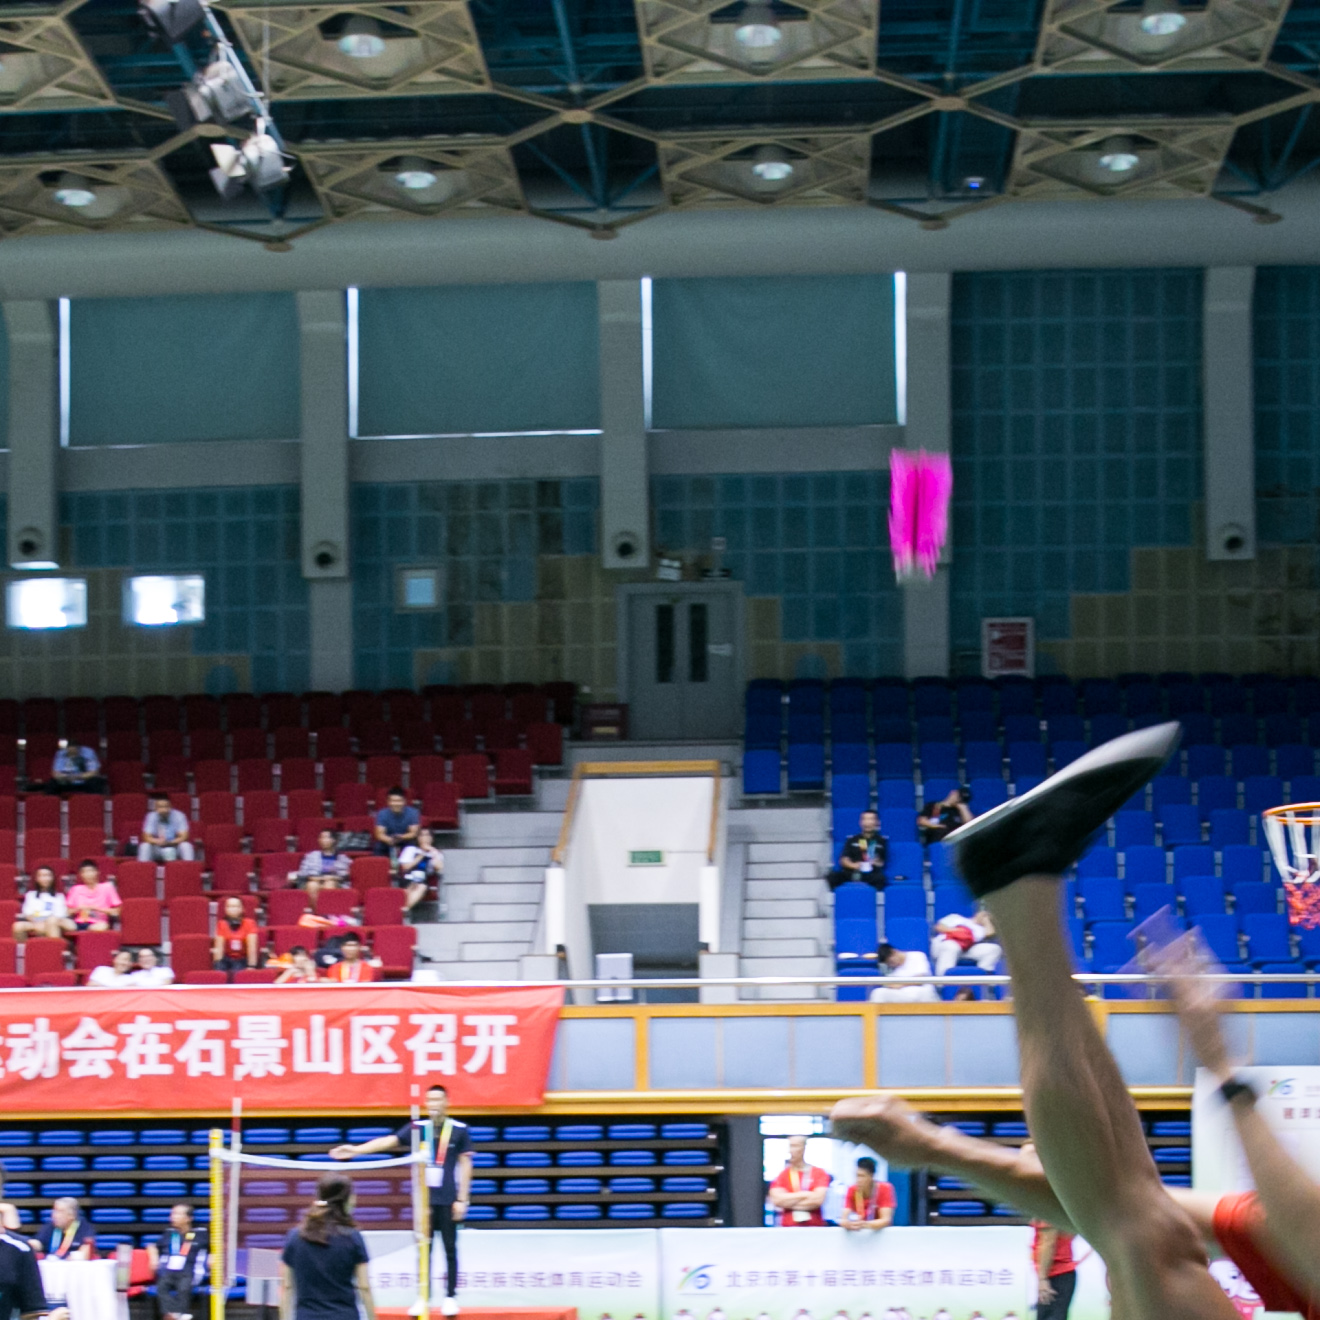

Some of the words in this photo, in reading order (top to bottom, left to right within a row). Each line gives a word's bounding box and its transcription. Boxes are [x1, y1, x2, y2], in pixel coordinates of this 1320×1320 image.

[726, 1269, 1015, 1288] 北京市第十届民族传统体育运动会
